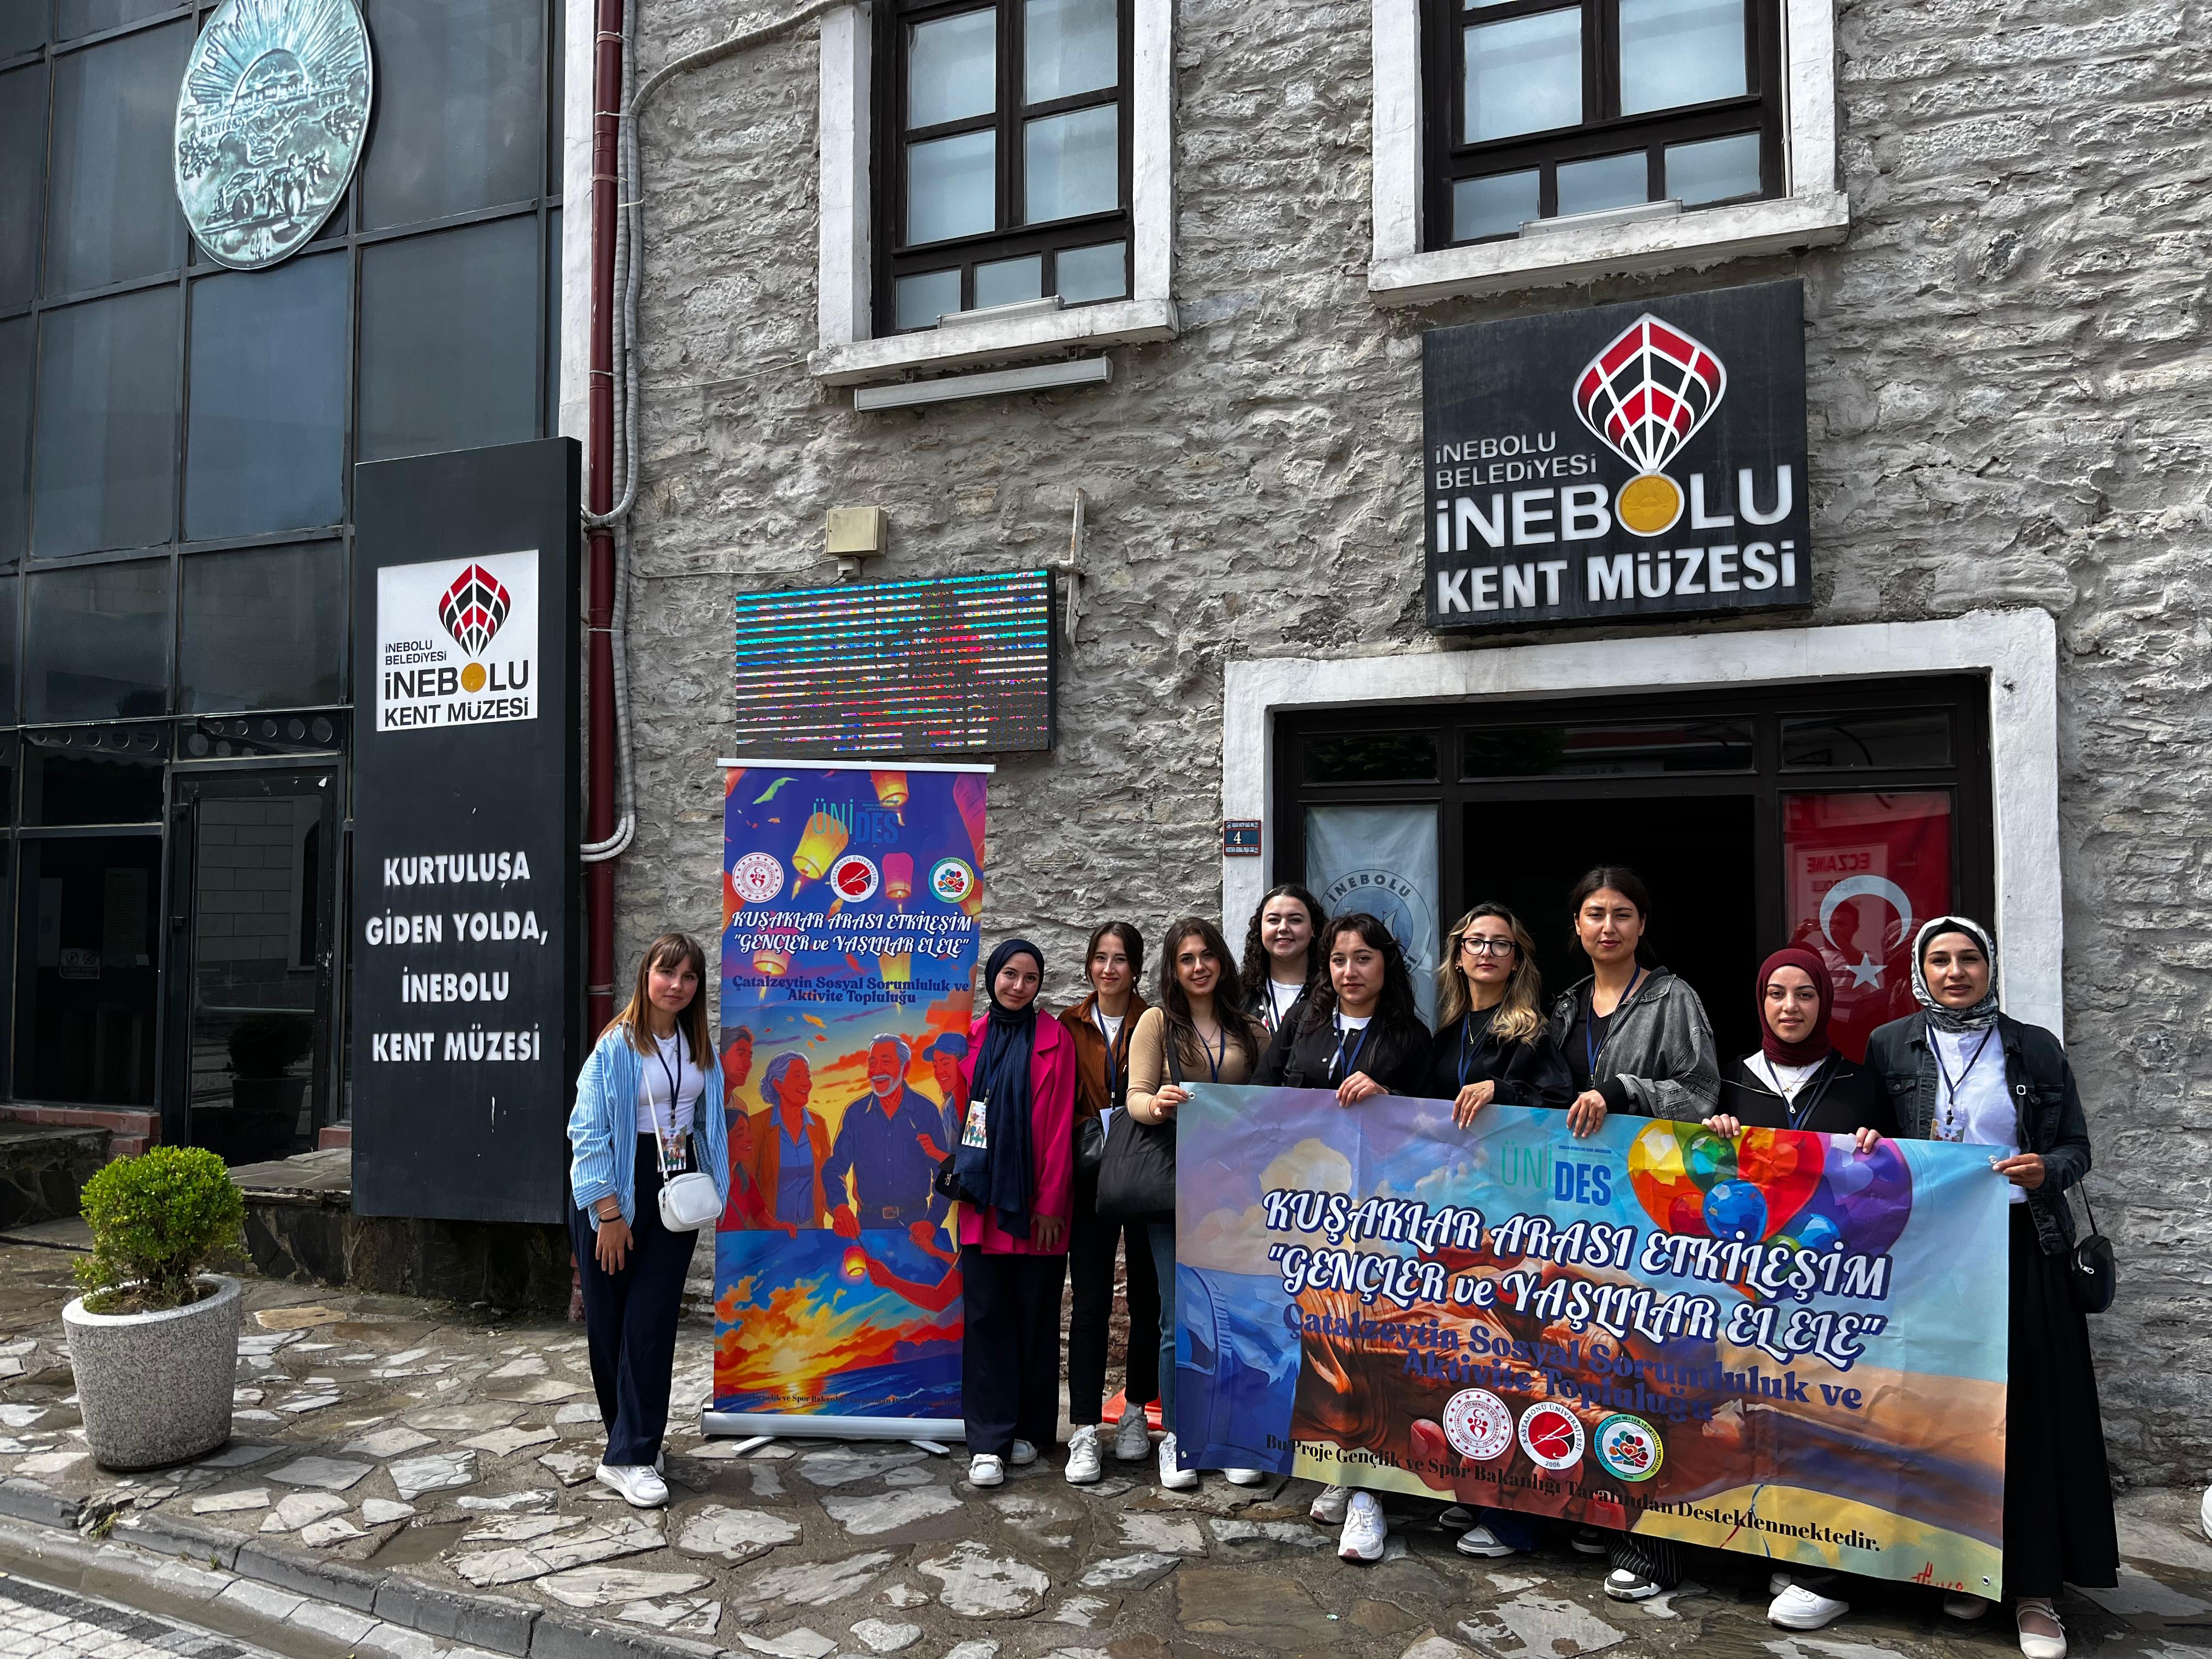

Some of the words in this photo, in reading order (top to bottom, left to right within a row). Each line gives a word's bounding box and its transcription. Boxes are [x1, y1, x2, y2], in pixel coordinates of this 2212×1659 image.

[1435, 431, 1556, 464] İNEBOLU
[1436, 453, 1597, 490] BELEDİYESİ
[1437, 560, 1567, 614] KENT
[1588, 540, 1795, 601] MÜZESİ
[385, 640, 432, 653] İNEBOLU
[385, 651, 447, 665] BELEDİYESİ
[385, 704, 441, 727] KENT
[448, 697, 528, 723] MÜZESİ
[1233, 831, 1242, 844] 4
[385, 851, 530, 888] KURTULUŞA
[1326, 874, 1410, 903] İNEBOLU
[365, 908, 442, 945] GİDEN
[452, 910, 548, 945] YOLDA,
[732, 911, 823, 932] KUŞAKLAR
[828, 913, 883, 930] ARASI
[887, 911, 972, 935] ETKİLEŞİM
[735, 934, 809, 954] "GENÇLER
[812, 939, 829, 950] ve
[832, 936, 913, 956] YAŞLILAR
[918, 938, 938, 958] EL
[402, 966, 509, 1002] İNEBOLU
[732, 975, 812, 991] Çatalzeytin
[816, 977, 863, 991] Sosyal
[867, 977, 950, 992] Sorumluluk
[954, 982, 969, 991] ve
[788, 989, 843, 1001] Aktivite
[847, 990, 916, 1005] Topluluğu
[373, 1032, 435, 1061] KENT
[444, 1023, 540, 1061] MÜZESİ
[1263, 1190, 1482, 1254] KUŞAKLAR
[1490, 1215, 1633, 1268] ARASI
[1640, 1231, 1886, 1301] ETKİLEŞİM
[1269, 1245, 1447, 1308] "GENÇLER
[1454, 1277, 1495, 1307] ve
[1502, 1273, 1716, 1344] YAŞLILAR
[1726, 1304, 1788, 1361] EL
[1783, 1310, 1881, 1369] ELE"
[1283, 1303, 1460, 1350] Çatalzeytin
[1468, 1325, 1579, 1369] Sosyal
[1588, 1344, 1810, 1403] Sorumluluk
[1819, 1384, 1863, 1409] ve
[792, 1395, 810, 1404] Spor
[1402, 1347, 1532, 1391] Aktivite
[1541, 1365, 1713, 1422] Topluluğu
[1521, 1404, 1547, 1444] KASTAMONU
[1549, 1403, 1582, 1451] ÜNİVERSİTESİ
[1266, 1434, 1286, 1451] Bu
[1291, 1439, 1333, 1462] Proje
[1336, 1448, 1402, 1469] Gençlik
[1405, 1458, 1424, 1471] ve
[1428, 1458, 1471, 1479] Spor
[1475, 1465, 1561, 1497] Bakanlığı
[1565, 1480, 1673, 1515] Tarafından
[1678, 1501, 1880, 1552] Desteklenmektedir.
